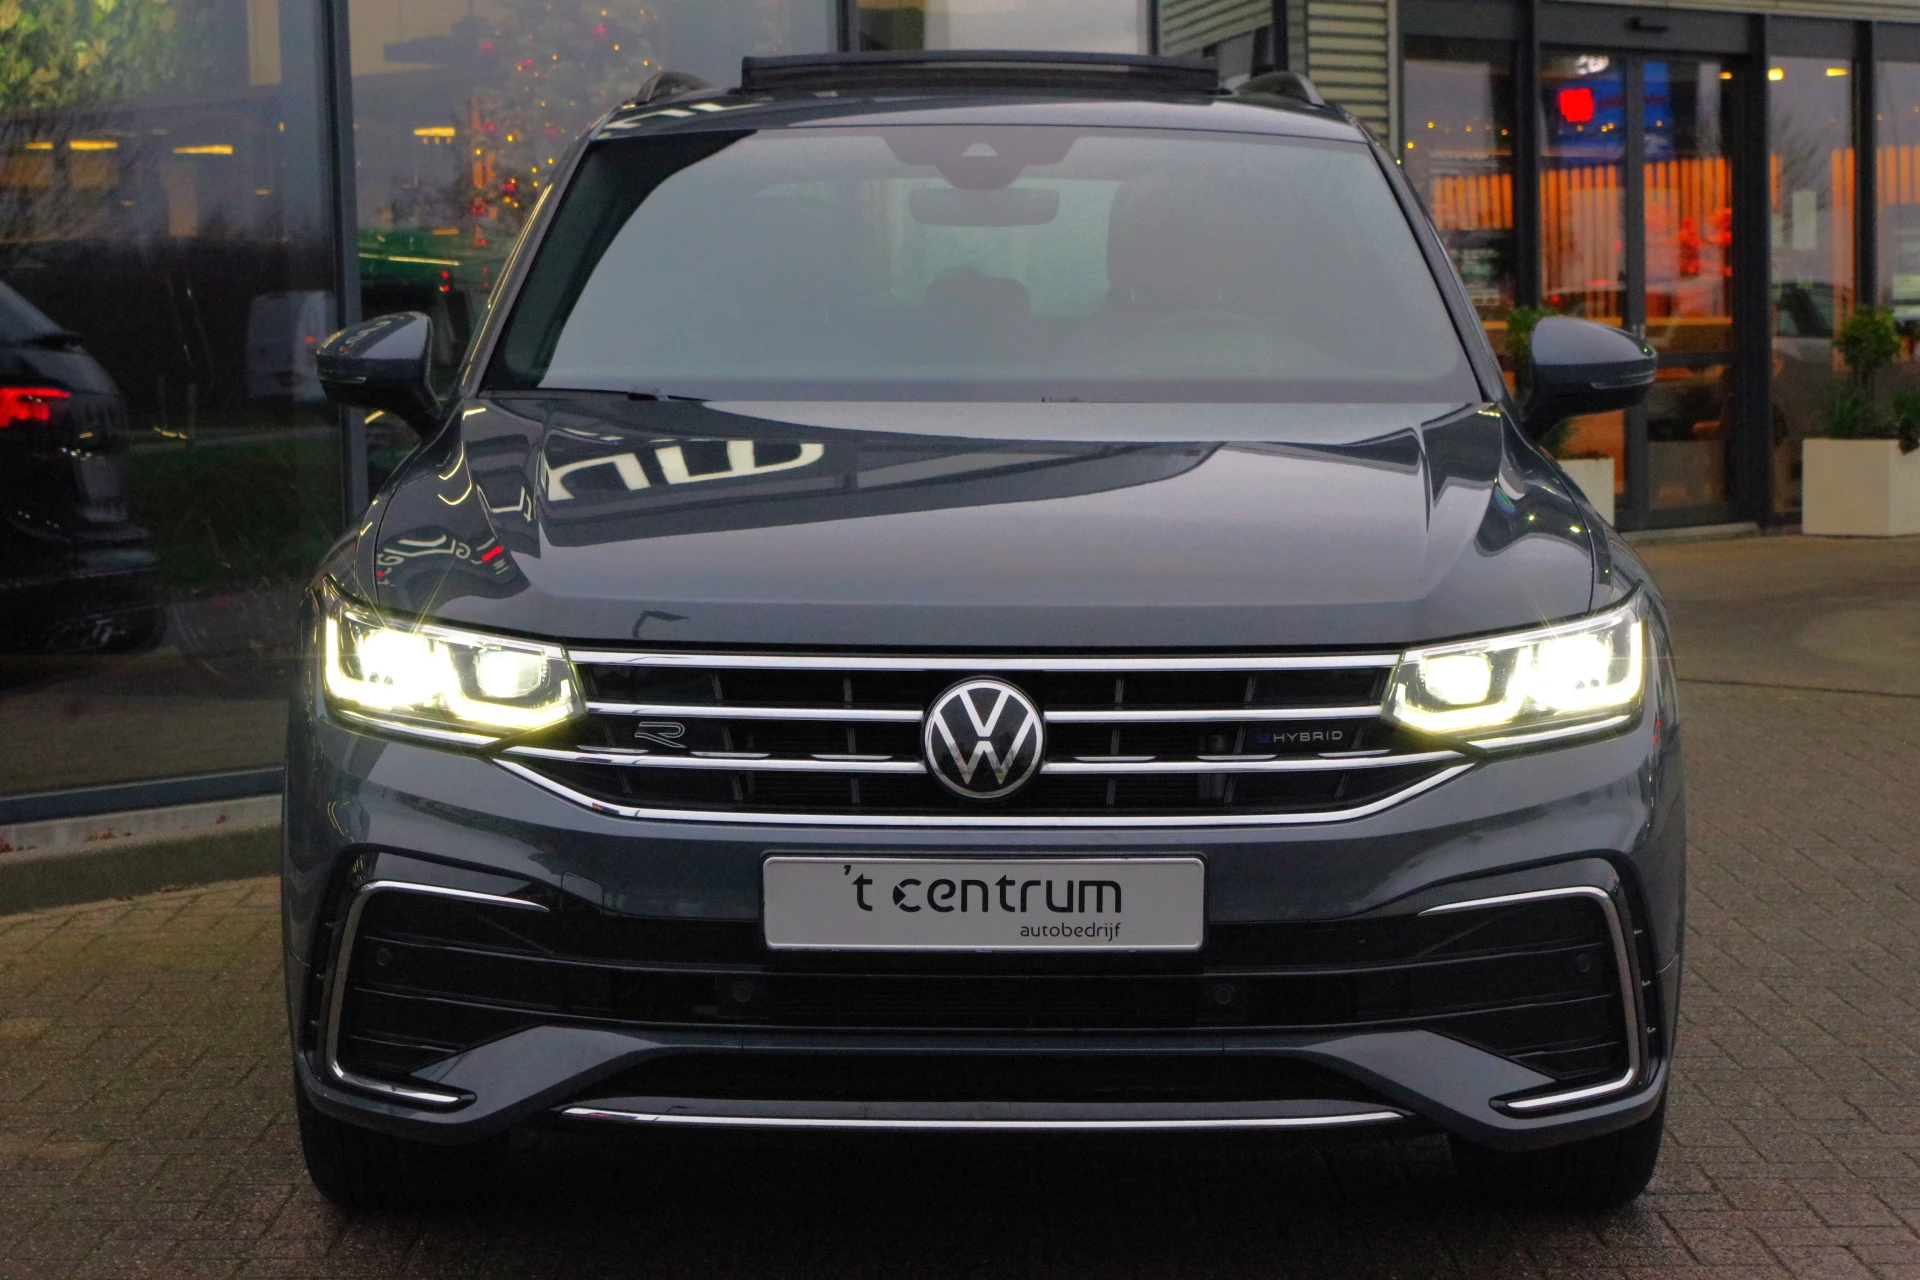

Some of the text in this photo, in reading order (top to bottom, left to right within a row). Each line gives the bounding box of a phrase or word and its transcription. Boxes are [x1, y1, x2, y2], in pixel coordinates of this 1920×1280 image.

[634, 721, 687, 749] R
[843, 864, 1122, 913] 't centrum
[1019, 922, 1121, 942] autobedrijf
